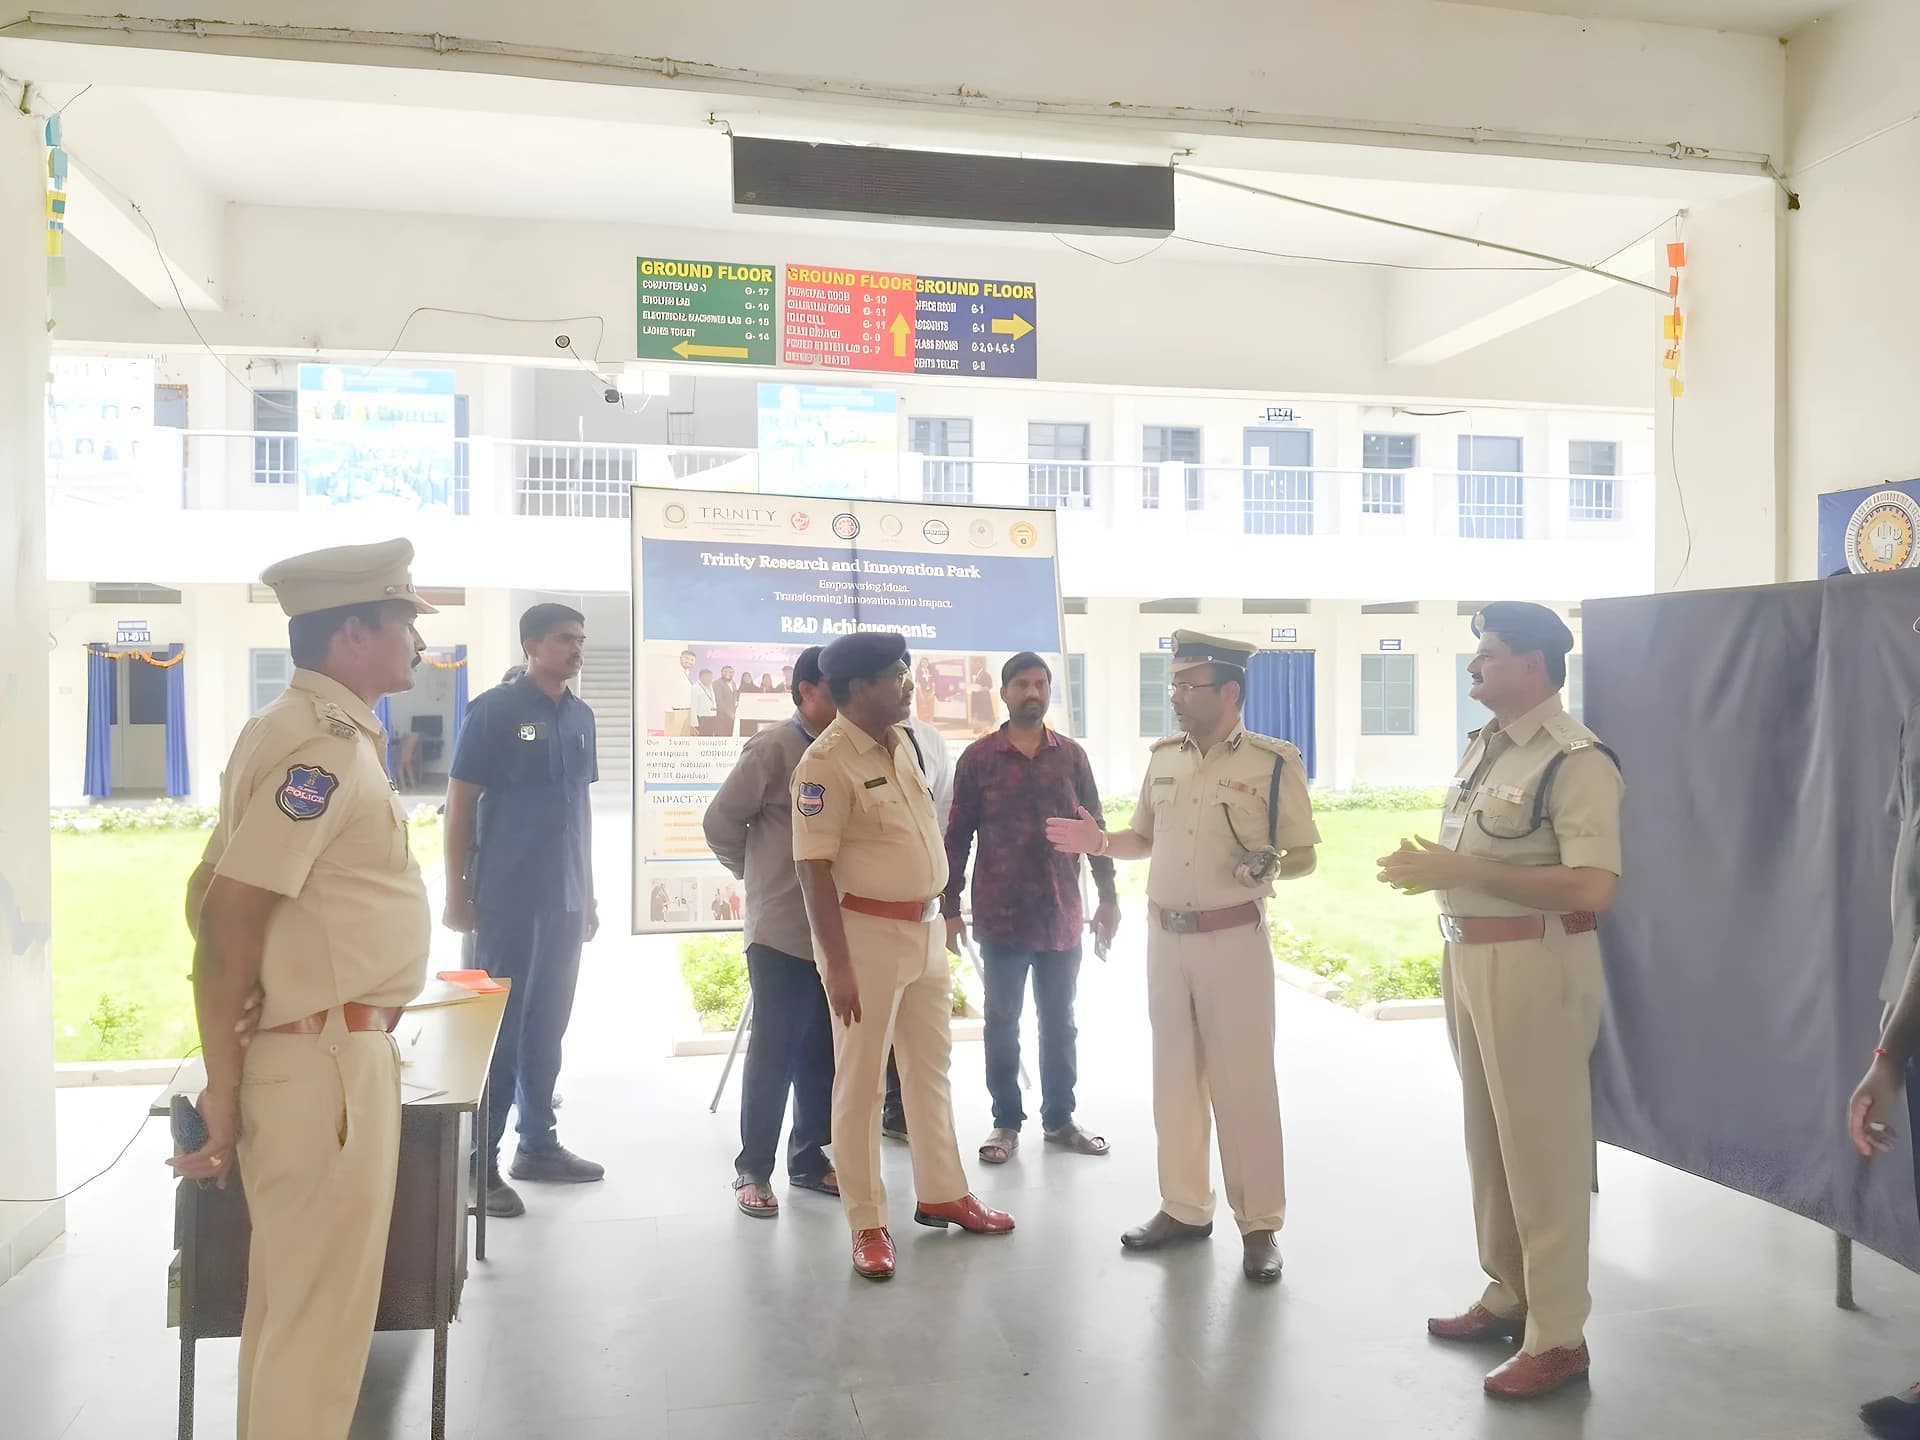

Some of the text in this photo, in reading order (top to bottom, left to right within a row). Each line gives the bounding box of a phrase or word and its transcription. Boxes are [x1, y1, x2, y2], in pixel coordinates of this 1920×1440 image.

[641, 260, 773, 282] GROUND FLOOR
[787, 268, 913, 292] GROUND FLOOR
[916, 280, 1035, 300] GROUND FLOOR
[698, 506, 777, 521] TRINITY
[700, 552, 982, 579] Trinity Research and Innovation Park
[781, 615, 818, 634] R&D
[285, 785, 325, 804] POLICE
